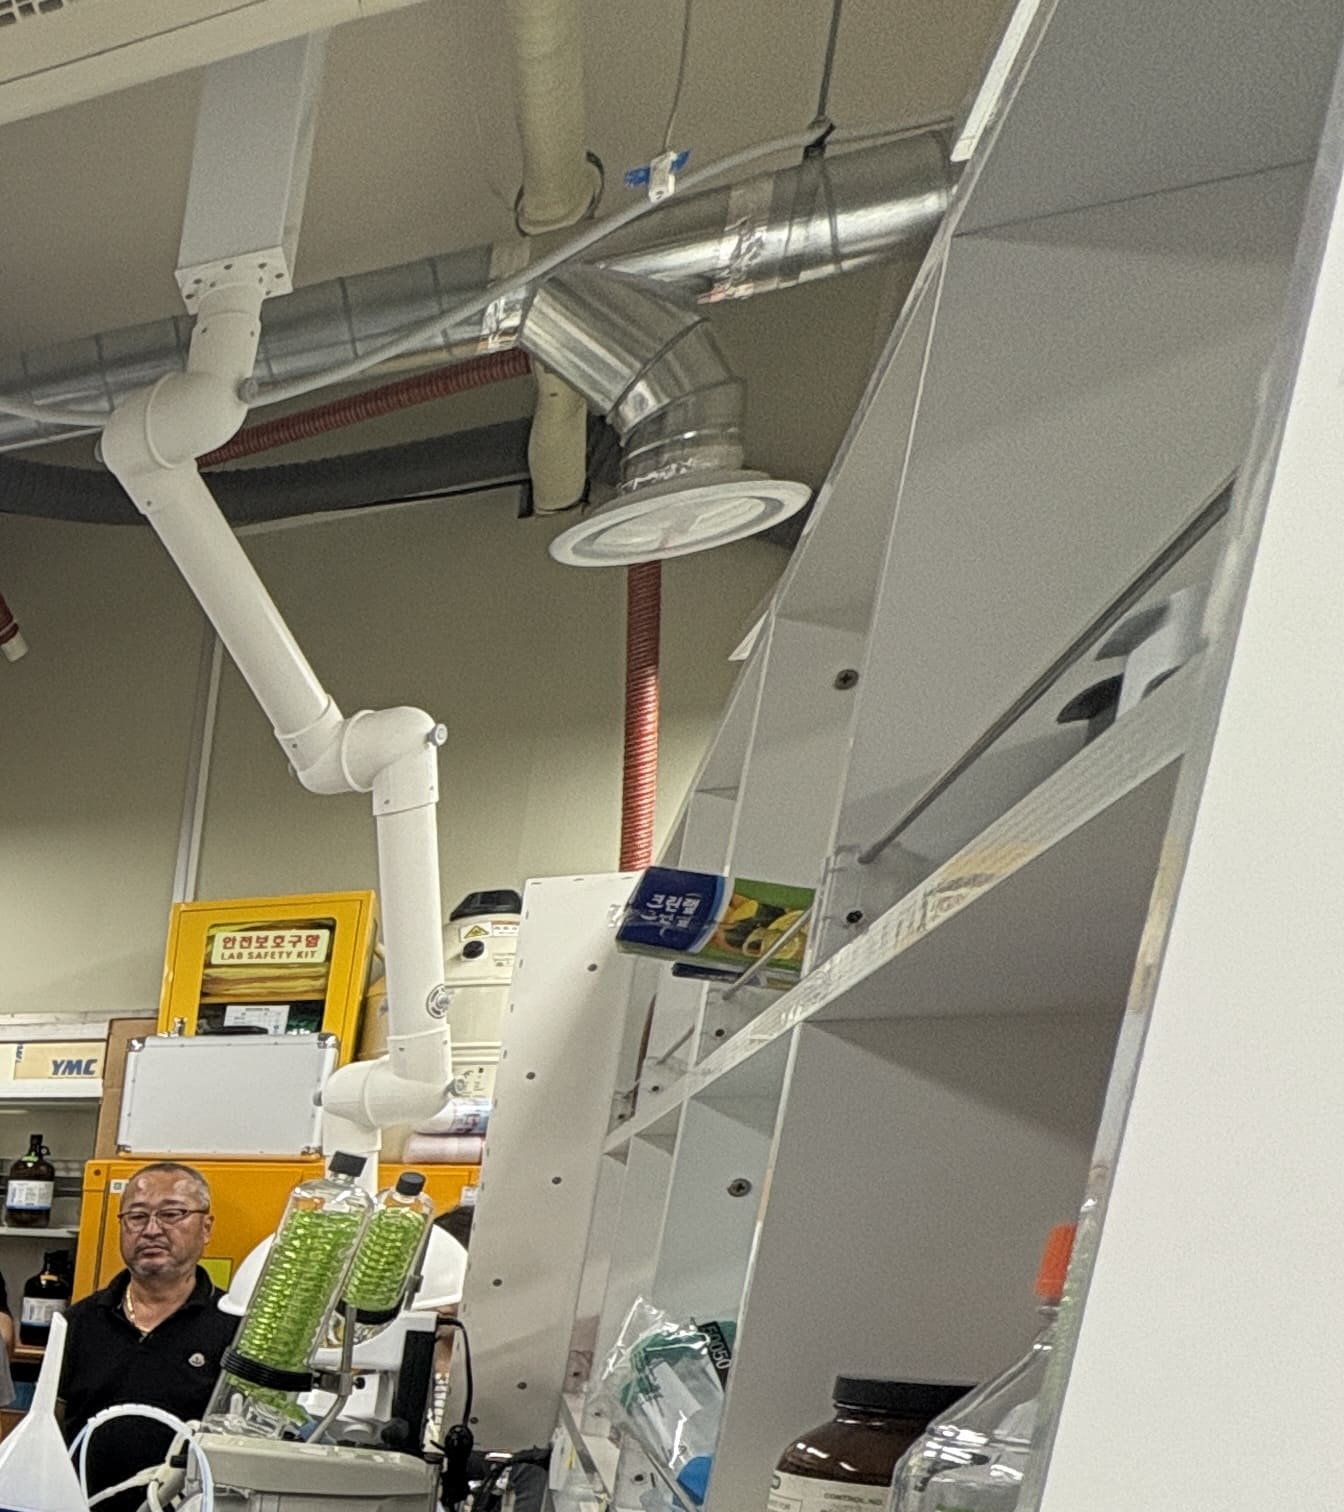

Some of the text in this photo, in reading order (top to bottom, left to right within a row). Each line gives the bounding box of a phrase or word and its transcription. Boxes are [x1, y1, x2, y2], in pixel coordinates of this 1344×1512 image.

[222, 934, 321, 950] 안전보호구함
[220, 950, 317, 961] LAB SAFETY KIT
[51, 1058, 98, 1076] YMC
